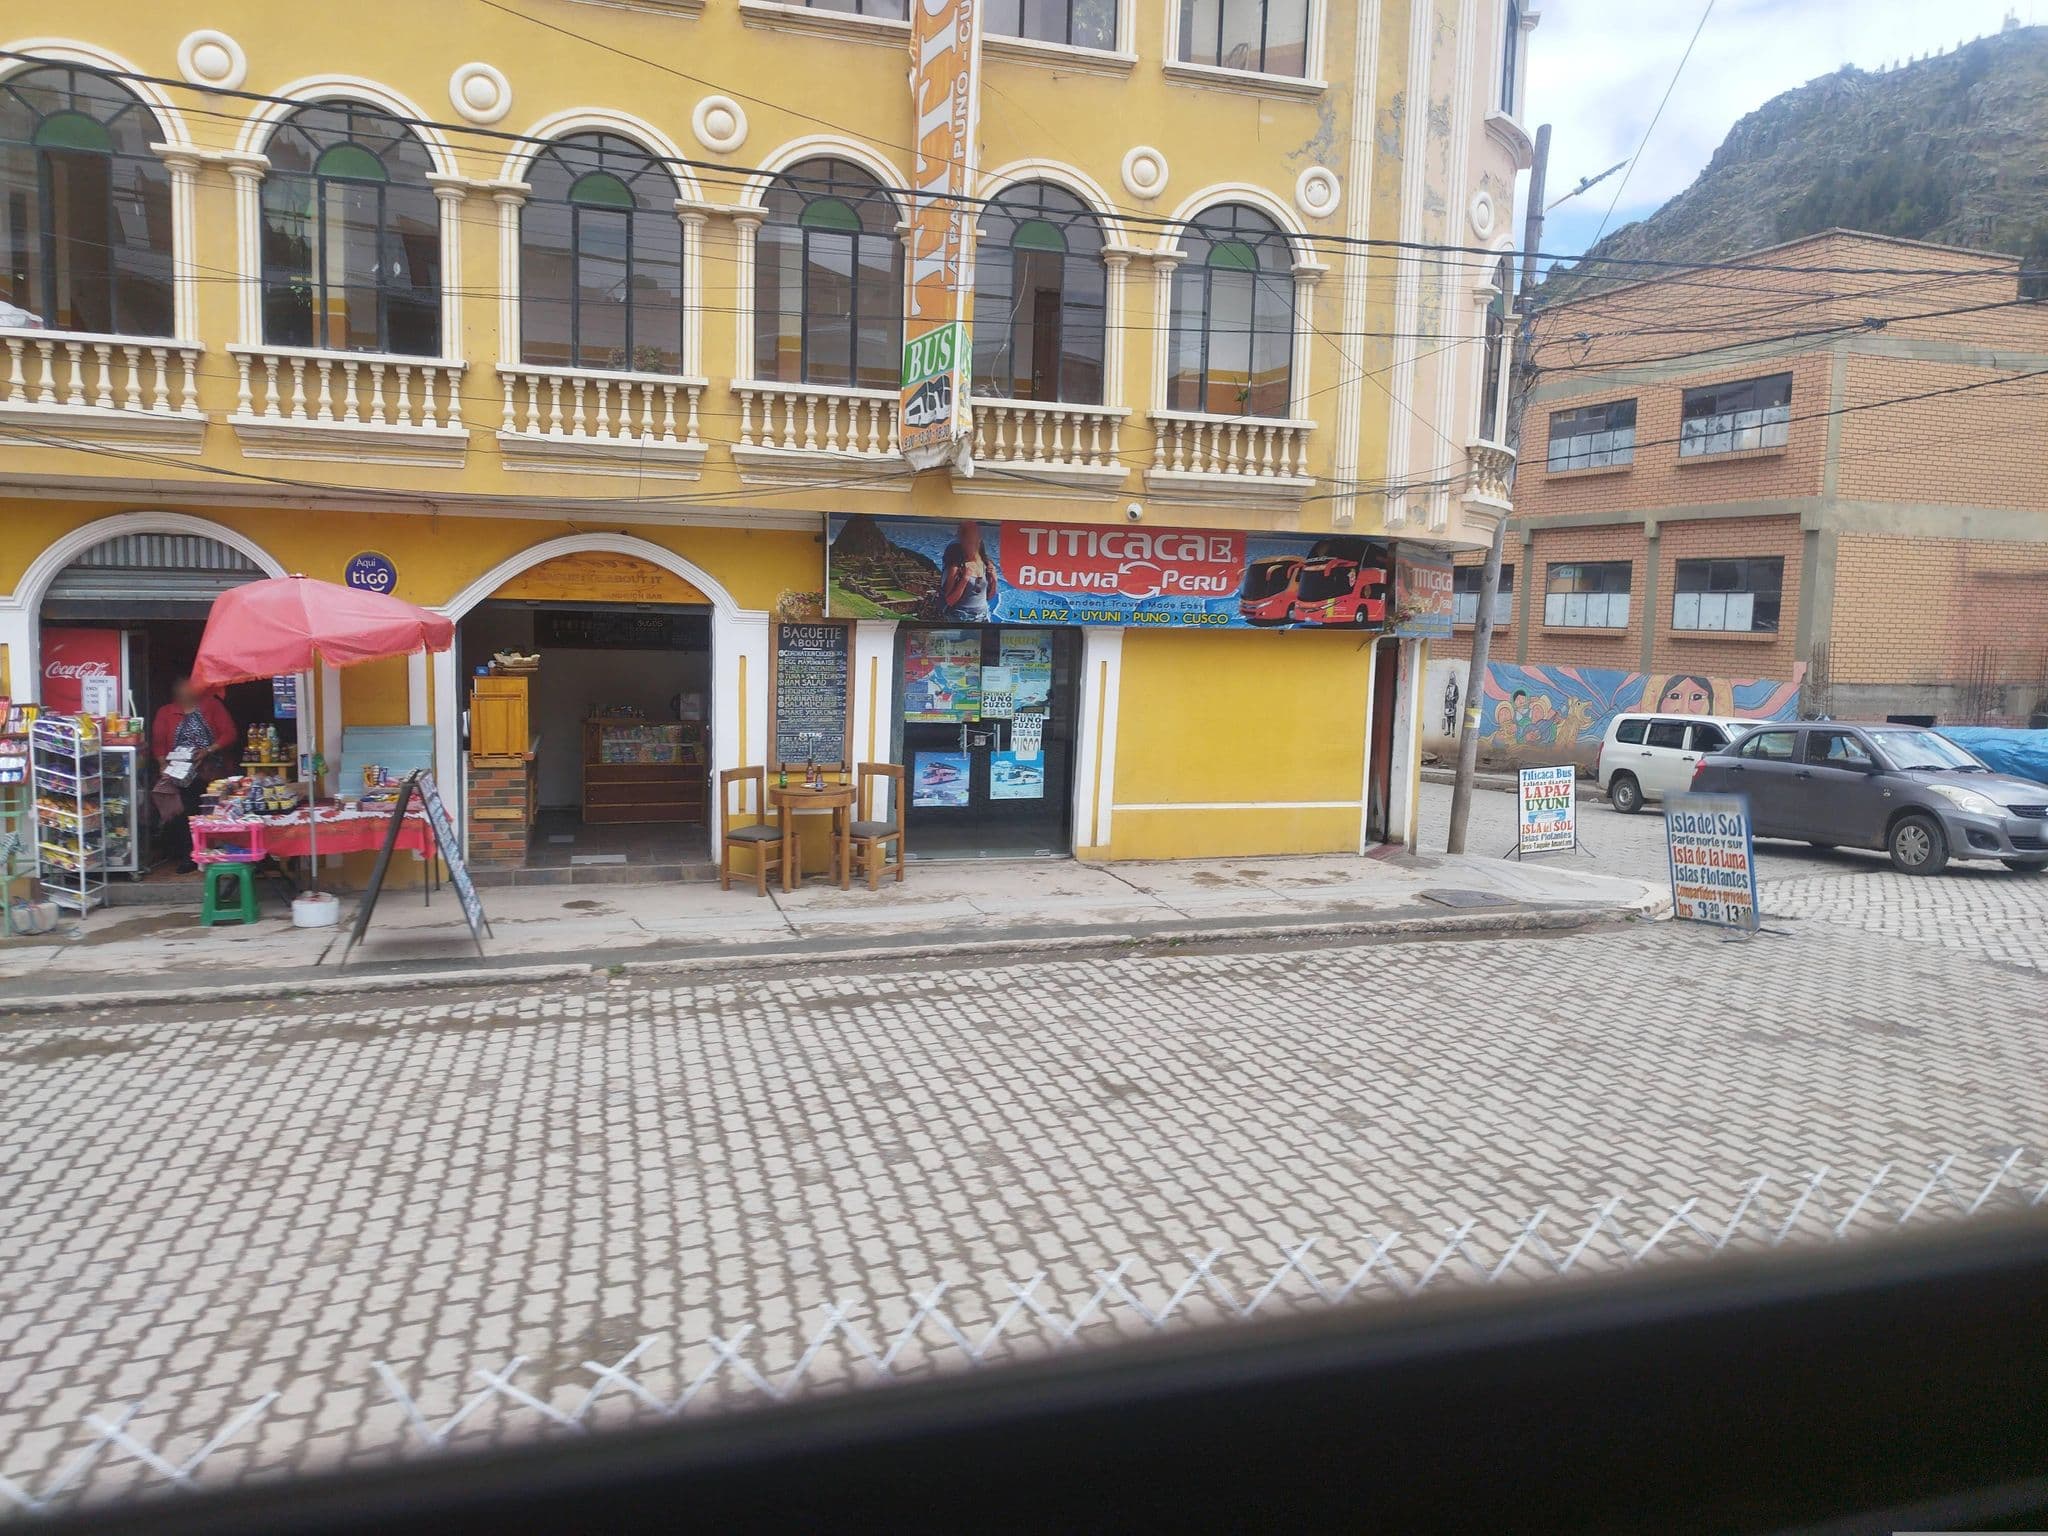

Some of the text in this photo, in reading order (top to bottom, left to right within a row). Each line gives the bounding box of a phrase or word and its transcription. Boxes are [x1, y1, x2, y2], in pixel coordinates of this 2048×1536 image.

[953, 70, 969, 160] PUNO
[906, 327, 953, 385] BUS
[1018, 527, 1206, 562] TITICACA
[352, 569, 388, 585] tigo
[1019, 565, 1228, 591] BOLIVIA PERÚ
[1019, 608, 1229, 624] LA PAZ UYUNI PUNO CUSCO
[783, 626, 841, 640] BAGUETTE
[789, 639, 825, 648] ABOUT
[1556, 768, 1573, 778] Bus
[1525, 784, 1570, 799] LA PAZ
[1525, 796, 1570, 811] UYUNI
[1522, 823, 1542, 834] ISLA
[1553, 820, 1573, 832] SOL
[1670, 812, 1744, 837] Isla del Sol
[1696, 836, 1720, 848] norte
[1727, 840, 1744, 850] sur
[1673, 846, 1747, 871] Isla de la Luna
[1675, 865, 1699, 883] Islas
